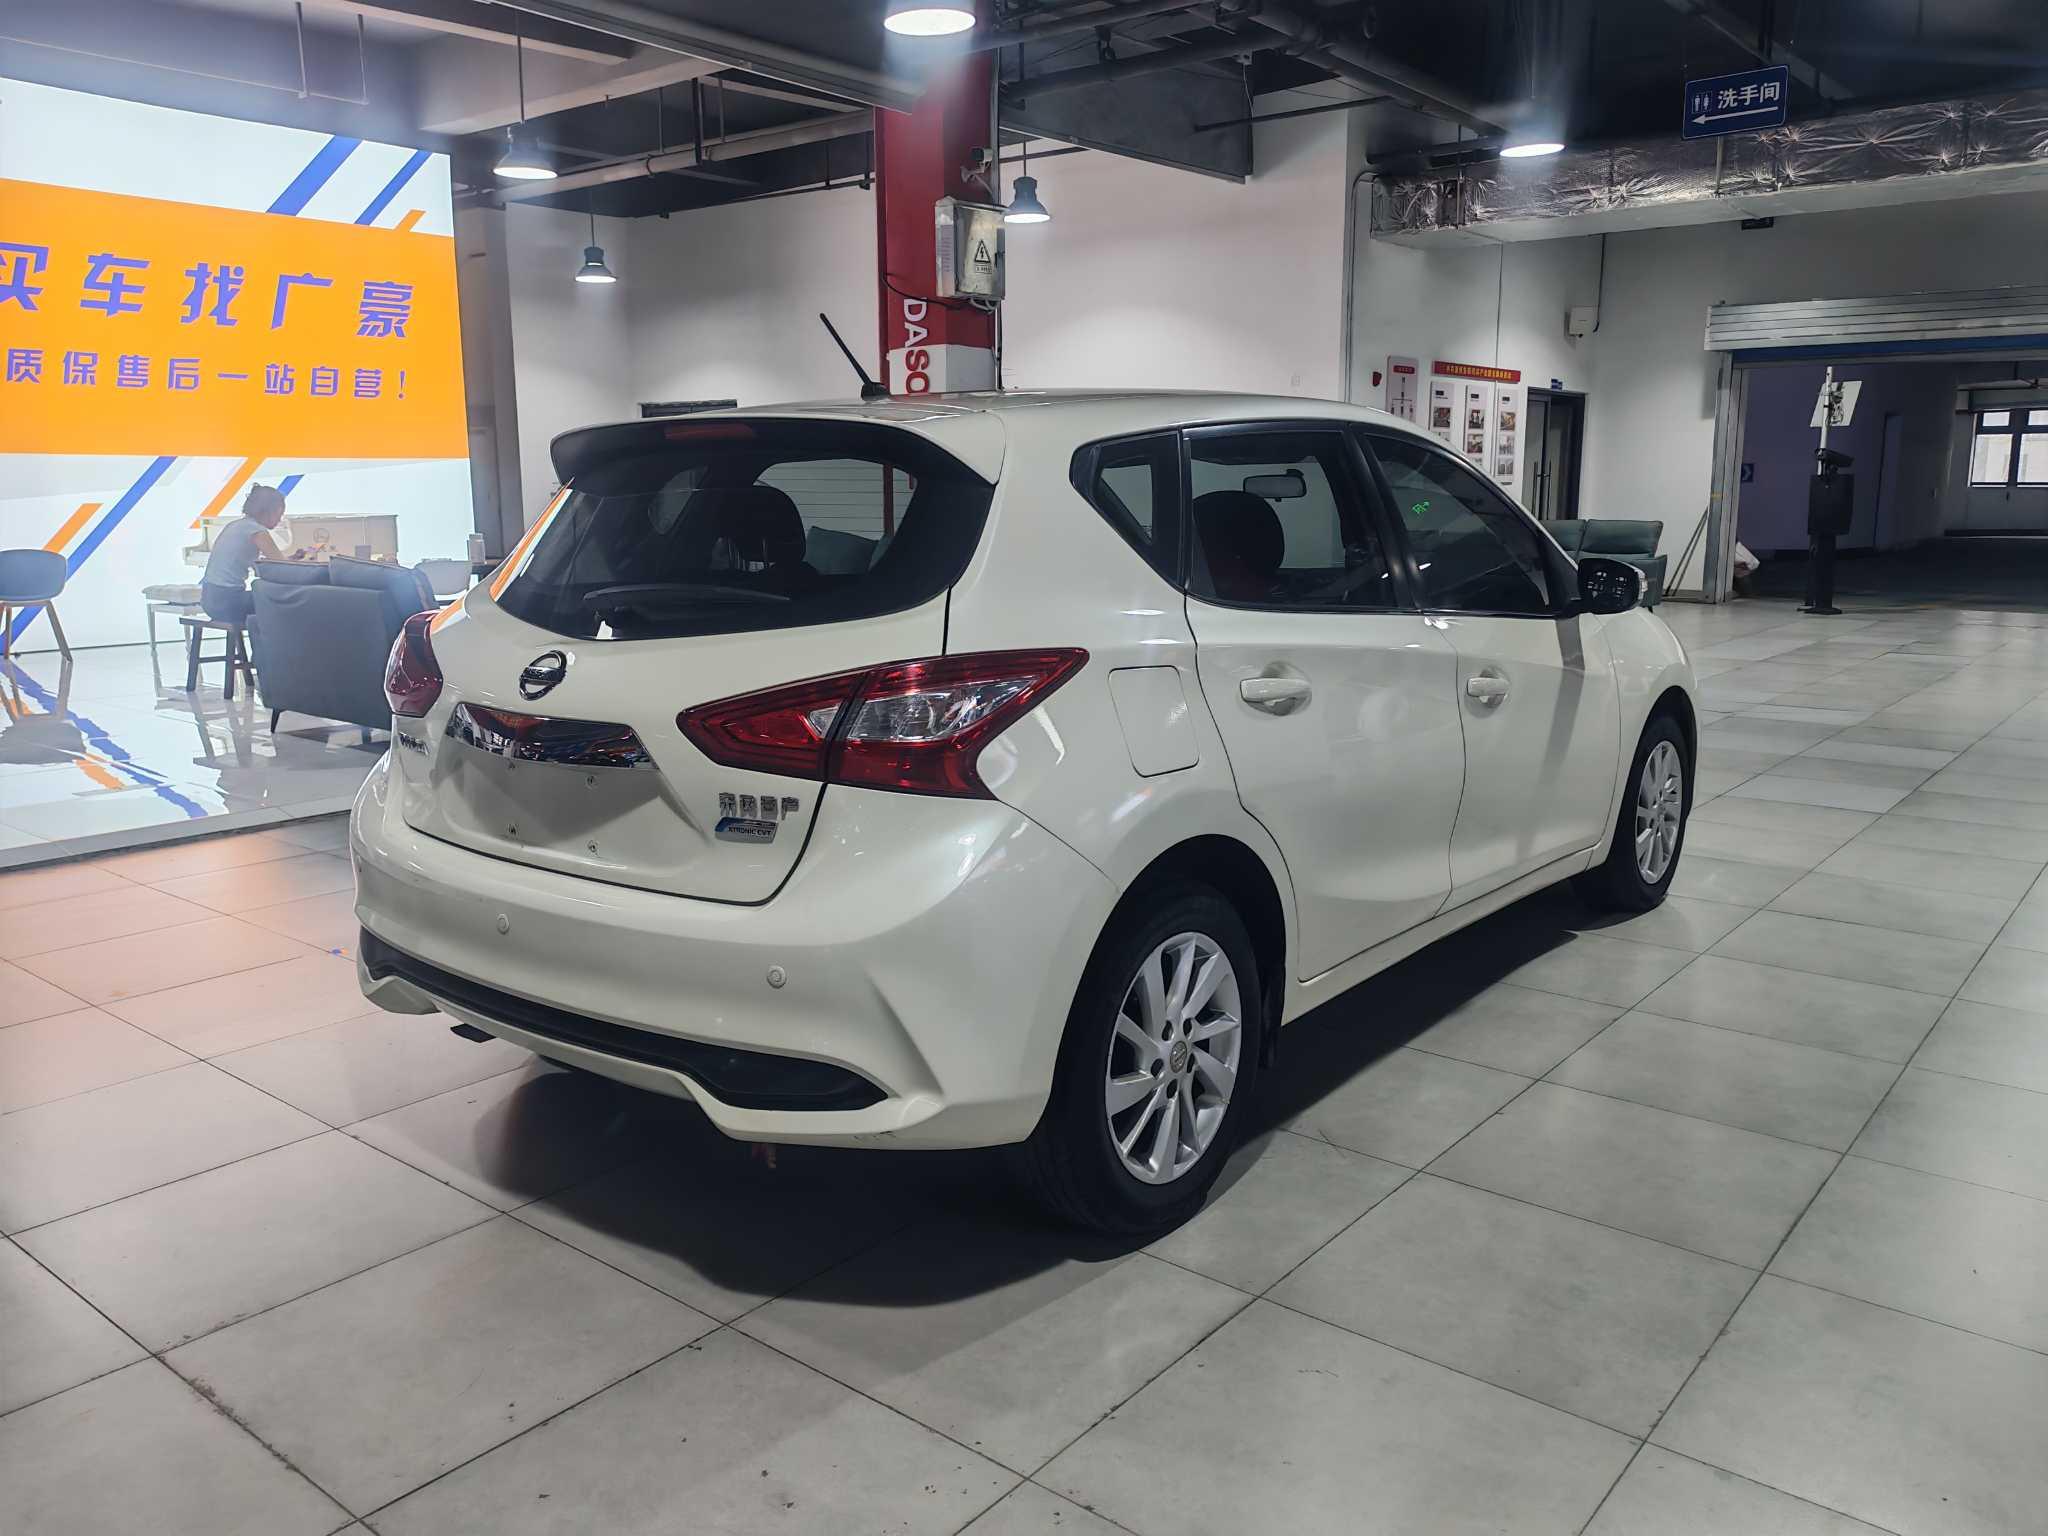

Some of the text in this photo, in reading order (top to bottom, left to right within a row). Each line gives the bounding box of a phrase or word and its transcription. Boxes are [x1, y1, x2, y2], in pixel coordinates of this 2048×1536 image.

[1718, 81, 1780, 109] 洗手间
[0, 241, 414, 338] 买车找广豪
